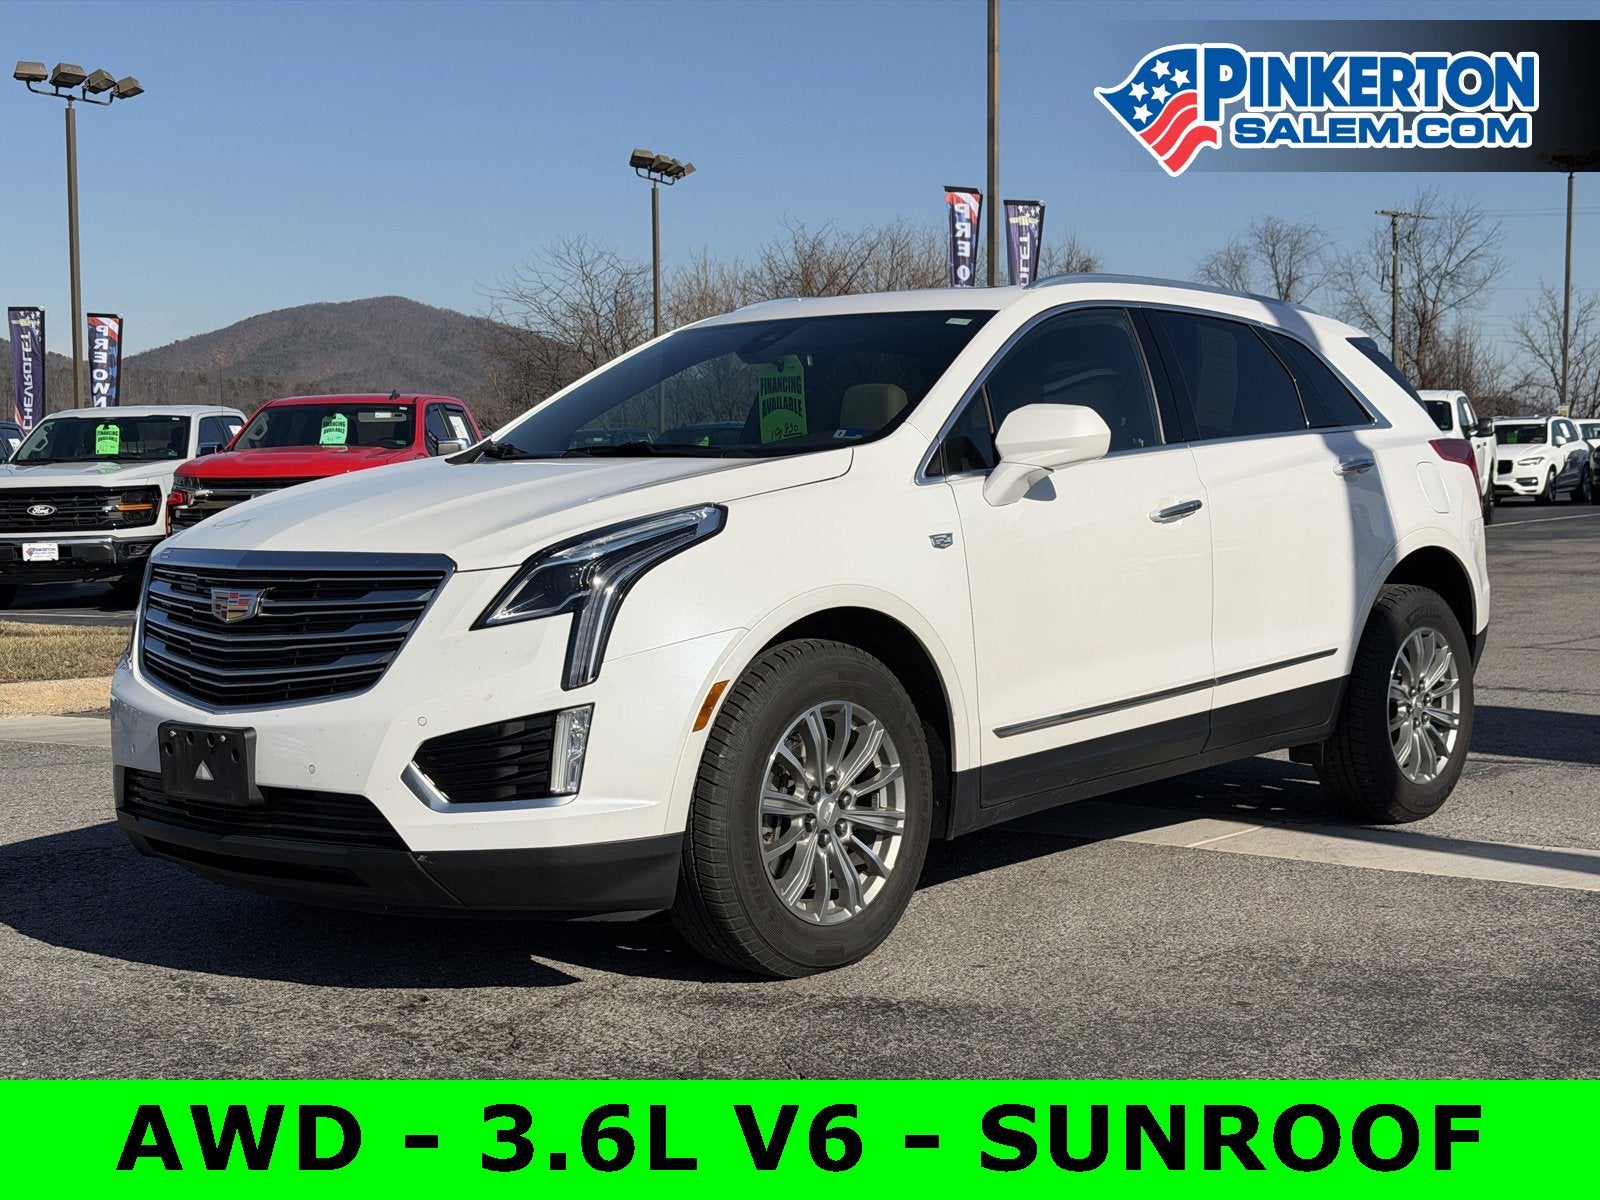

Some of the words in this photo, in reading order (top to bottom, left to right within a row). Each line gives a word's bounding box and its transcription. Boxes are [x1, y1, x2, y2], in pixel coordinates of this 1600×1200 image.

[760, 375, 802, 396] FINANCING
[762, 396, 803, 419] AVAILABLE
[32, 506, 50, 514] Ford
